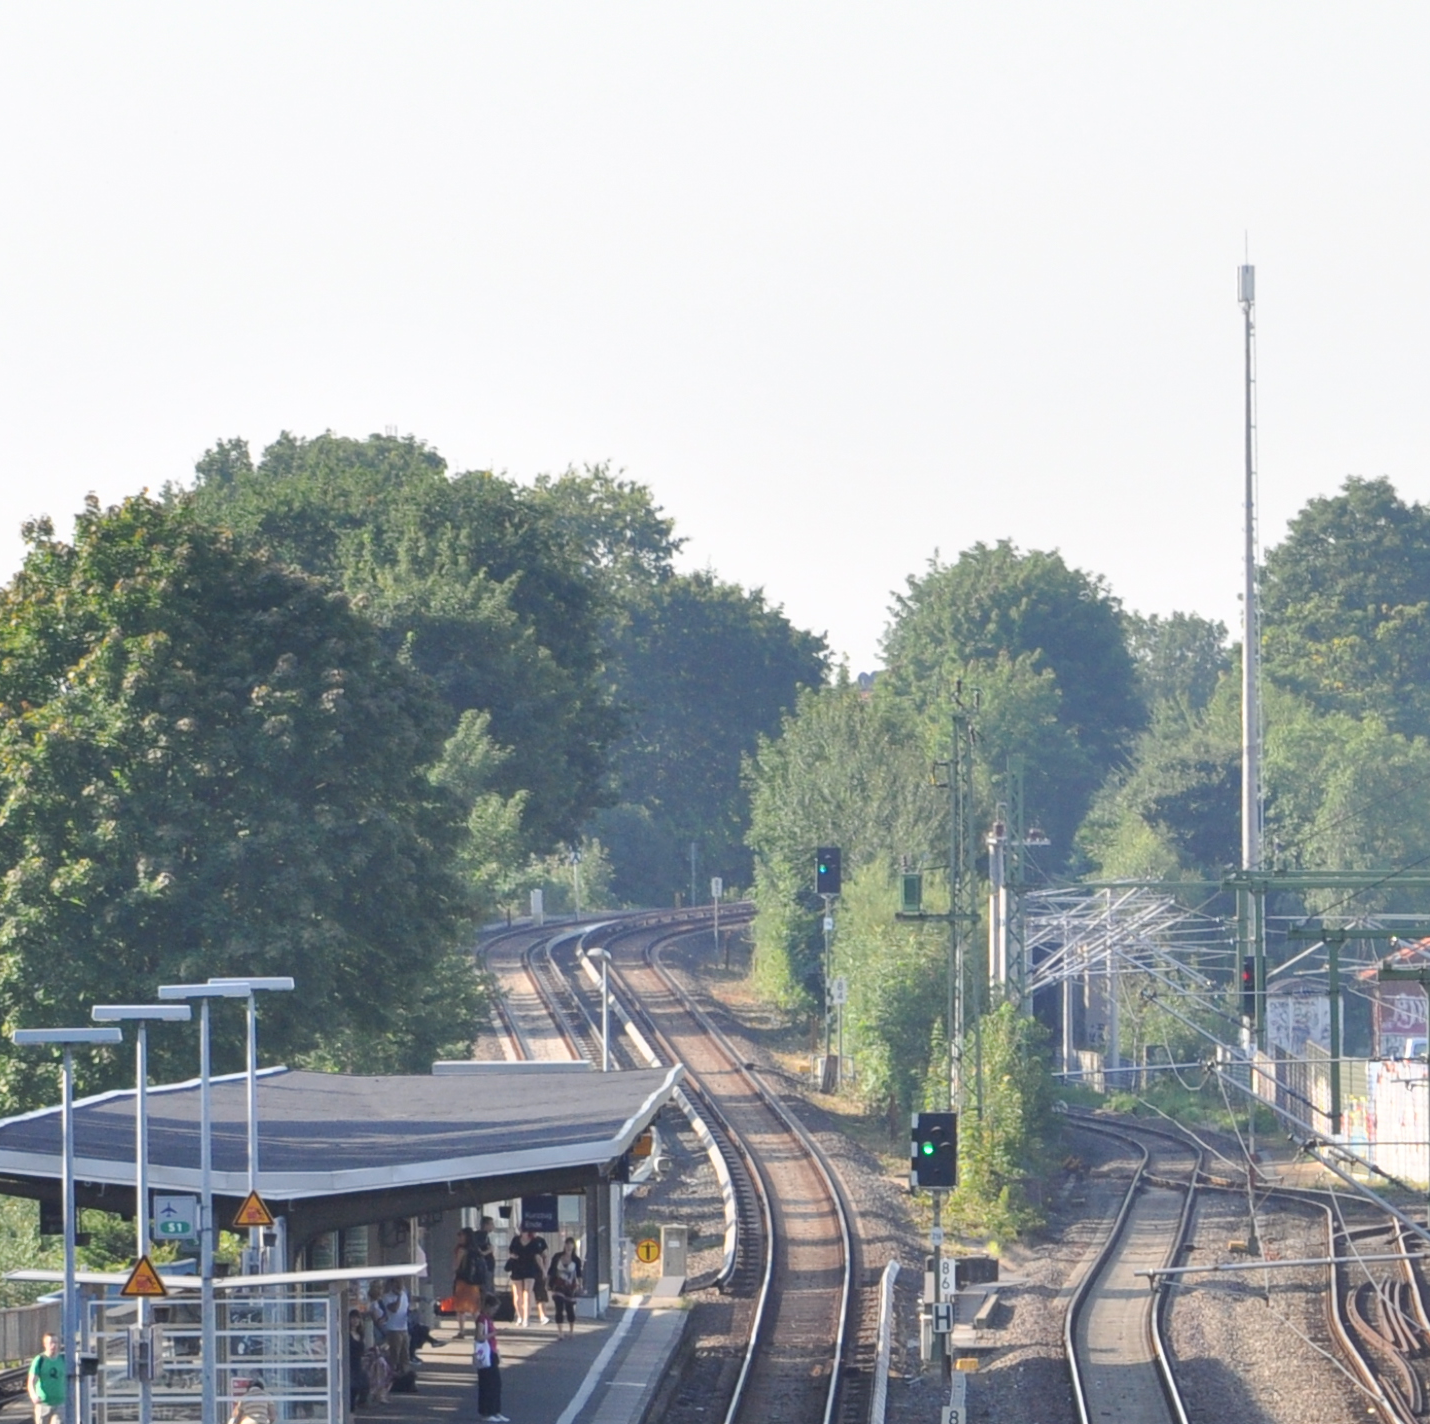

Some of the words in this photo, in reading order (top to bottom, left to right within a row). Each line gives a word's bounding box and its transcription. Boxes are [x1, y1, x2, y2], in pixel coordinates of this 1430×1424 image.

[167, 1222, 183, 1232] S1
[942, 1262, 950, 1275] 8
[941, 1277, 950, 1290] 6
[934, 1305, 951, 1331] H
